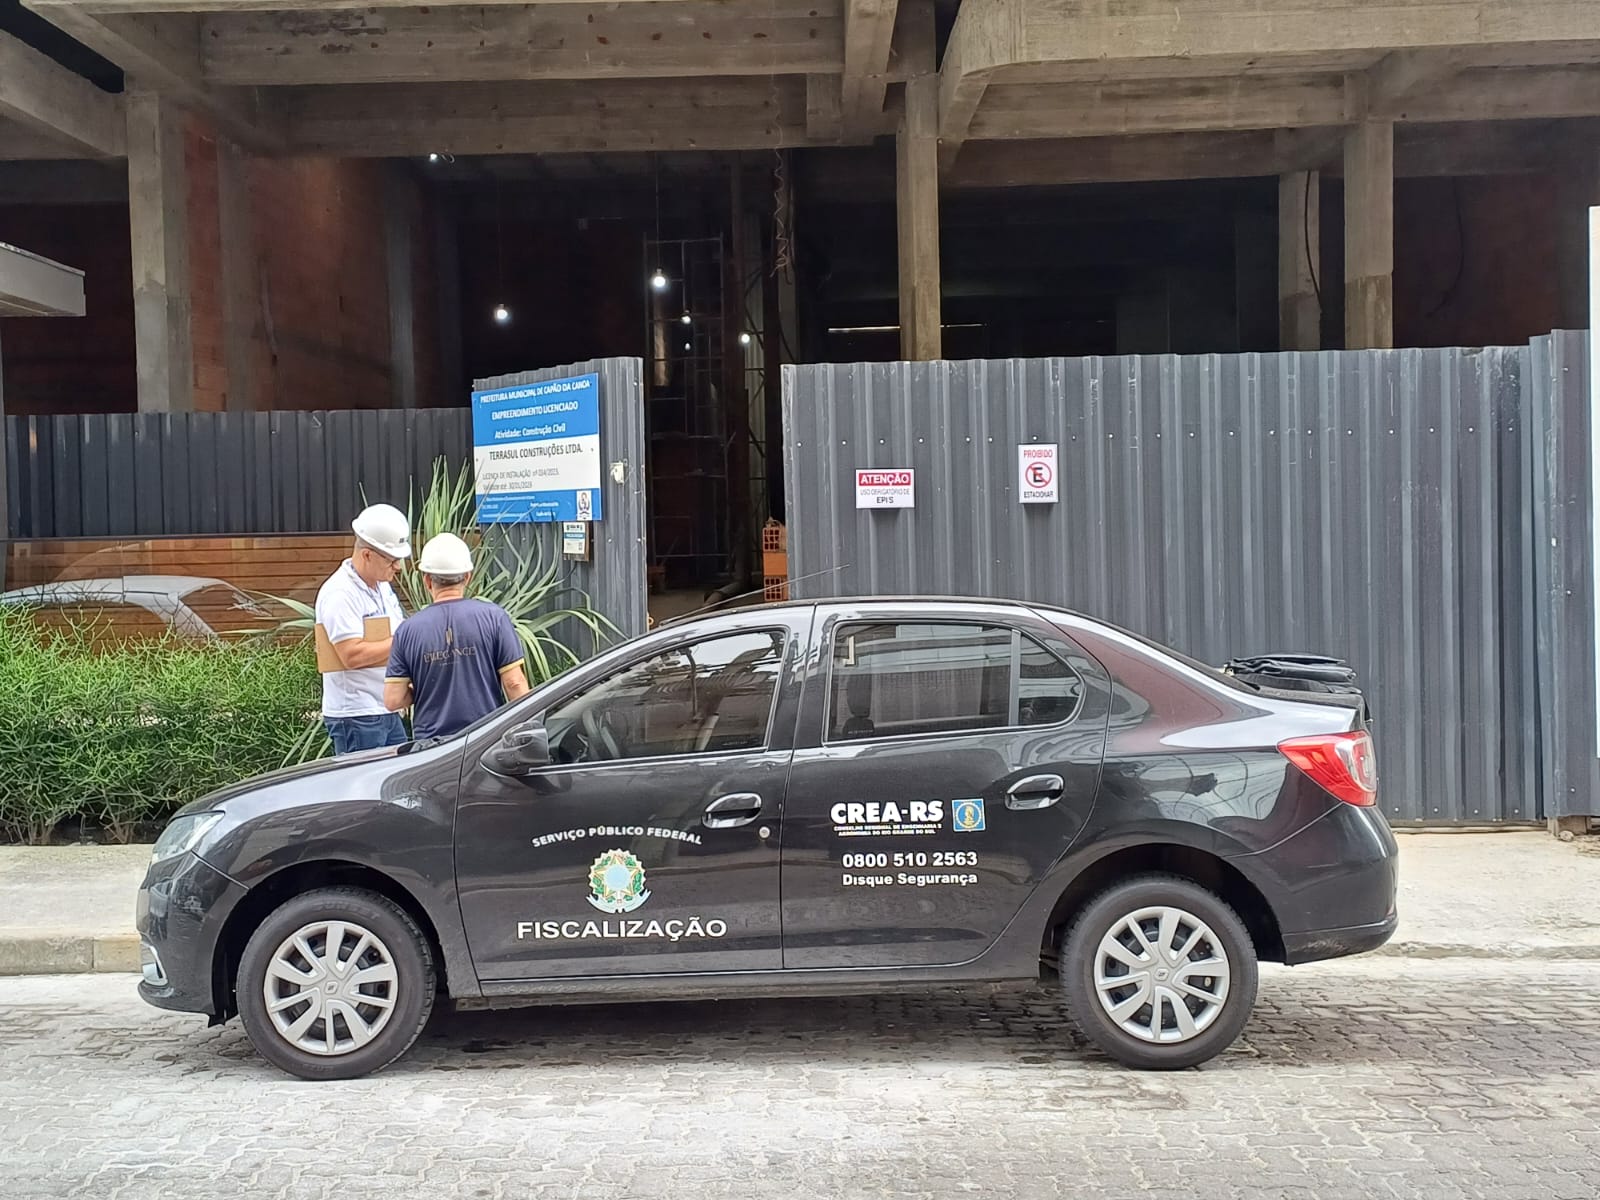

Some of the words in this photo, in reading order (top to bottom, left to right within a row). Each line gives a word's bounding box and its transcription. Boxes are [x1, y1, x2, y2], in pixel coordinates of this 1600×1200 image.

[480, 393, 508, 403] PREFEITURA
[509, 388, 536, 400] MUNICIPAL
[536, 387, 543, 396] DE
[544, 383, 561, 395] CAPÃO
[562, 383, 571, 393] DA
[491, 405, 543, 420] EMPREENDIMENTO
[543, 401, 579, 414] LICENCIADO
[494, 428, 522, 440] Atividade:
[522, 424, 552, 437] Construção
[552, 422, 566, 433] Civil
[489, 448, 519, 461] TERRASUL
[519, 443, 564, 459] CONSTRUÇÕES
[565, 443, 583, 454] LTDA.
[1023, 449, 1054, 458] PROIBIDO
[860, 472, 910, 486] ATENÇÃO
[423, 646, 476, 663] ELEGNCE
[830, 800, 944, 824] CREA-RS
[531, 828, 586, 848] SERVIÇO
[588, 825, 644, 837] PÚBLICO
[646, 826, 703, 845] FEDERAL
[842, 852, 888, 868] 0800
[893, 852, 928, 867] 510
[932, 851, 978, 867] 2563
[842, 873, 894, 887] Disque
[897, 872, 978, 887] Segurança
[516, 916, 728, 941] FISCALIZAÇÃO
